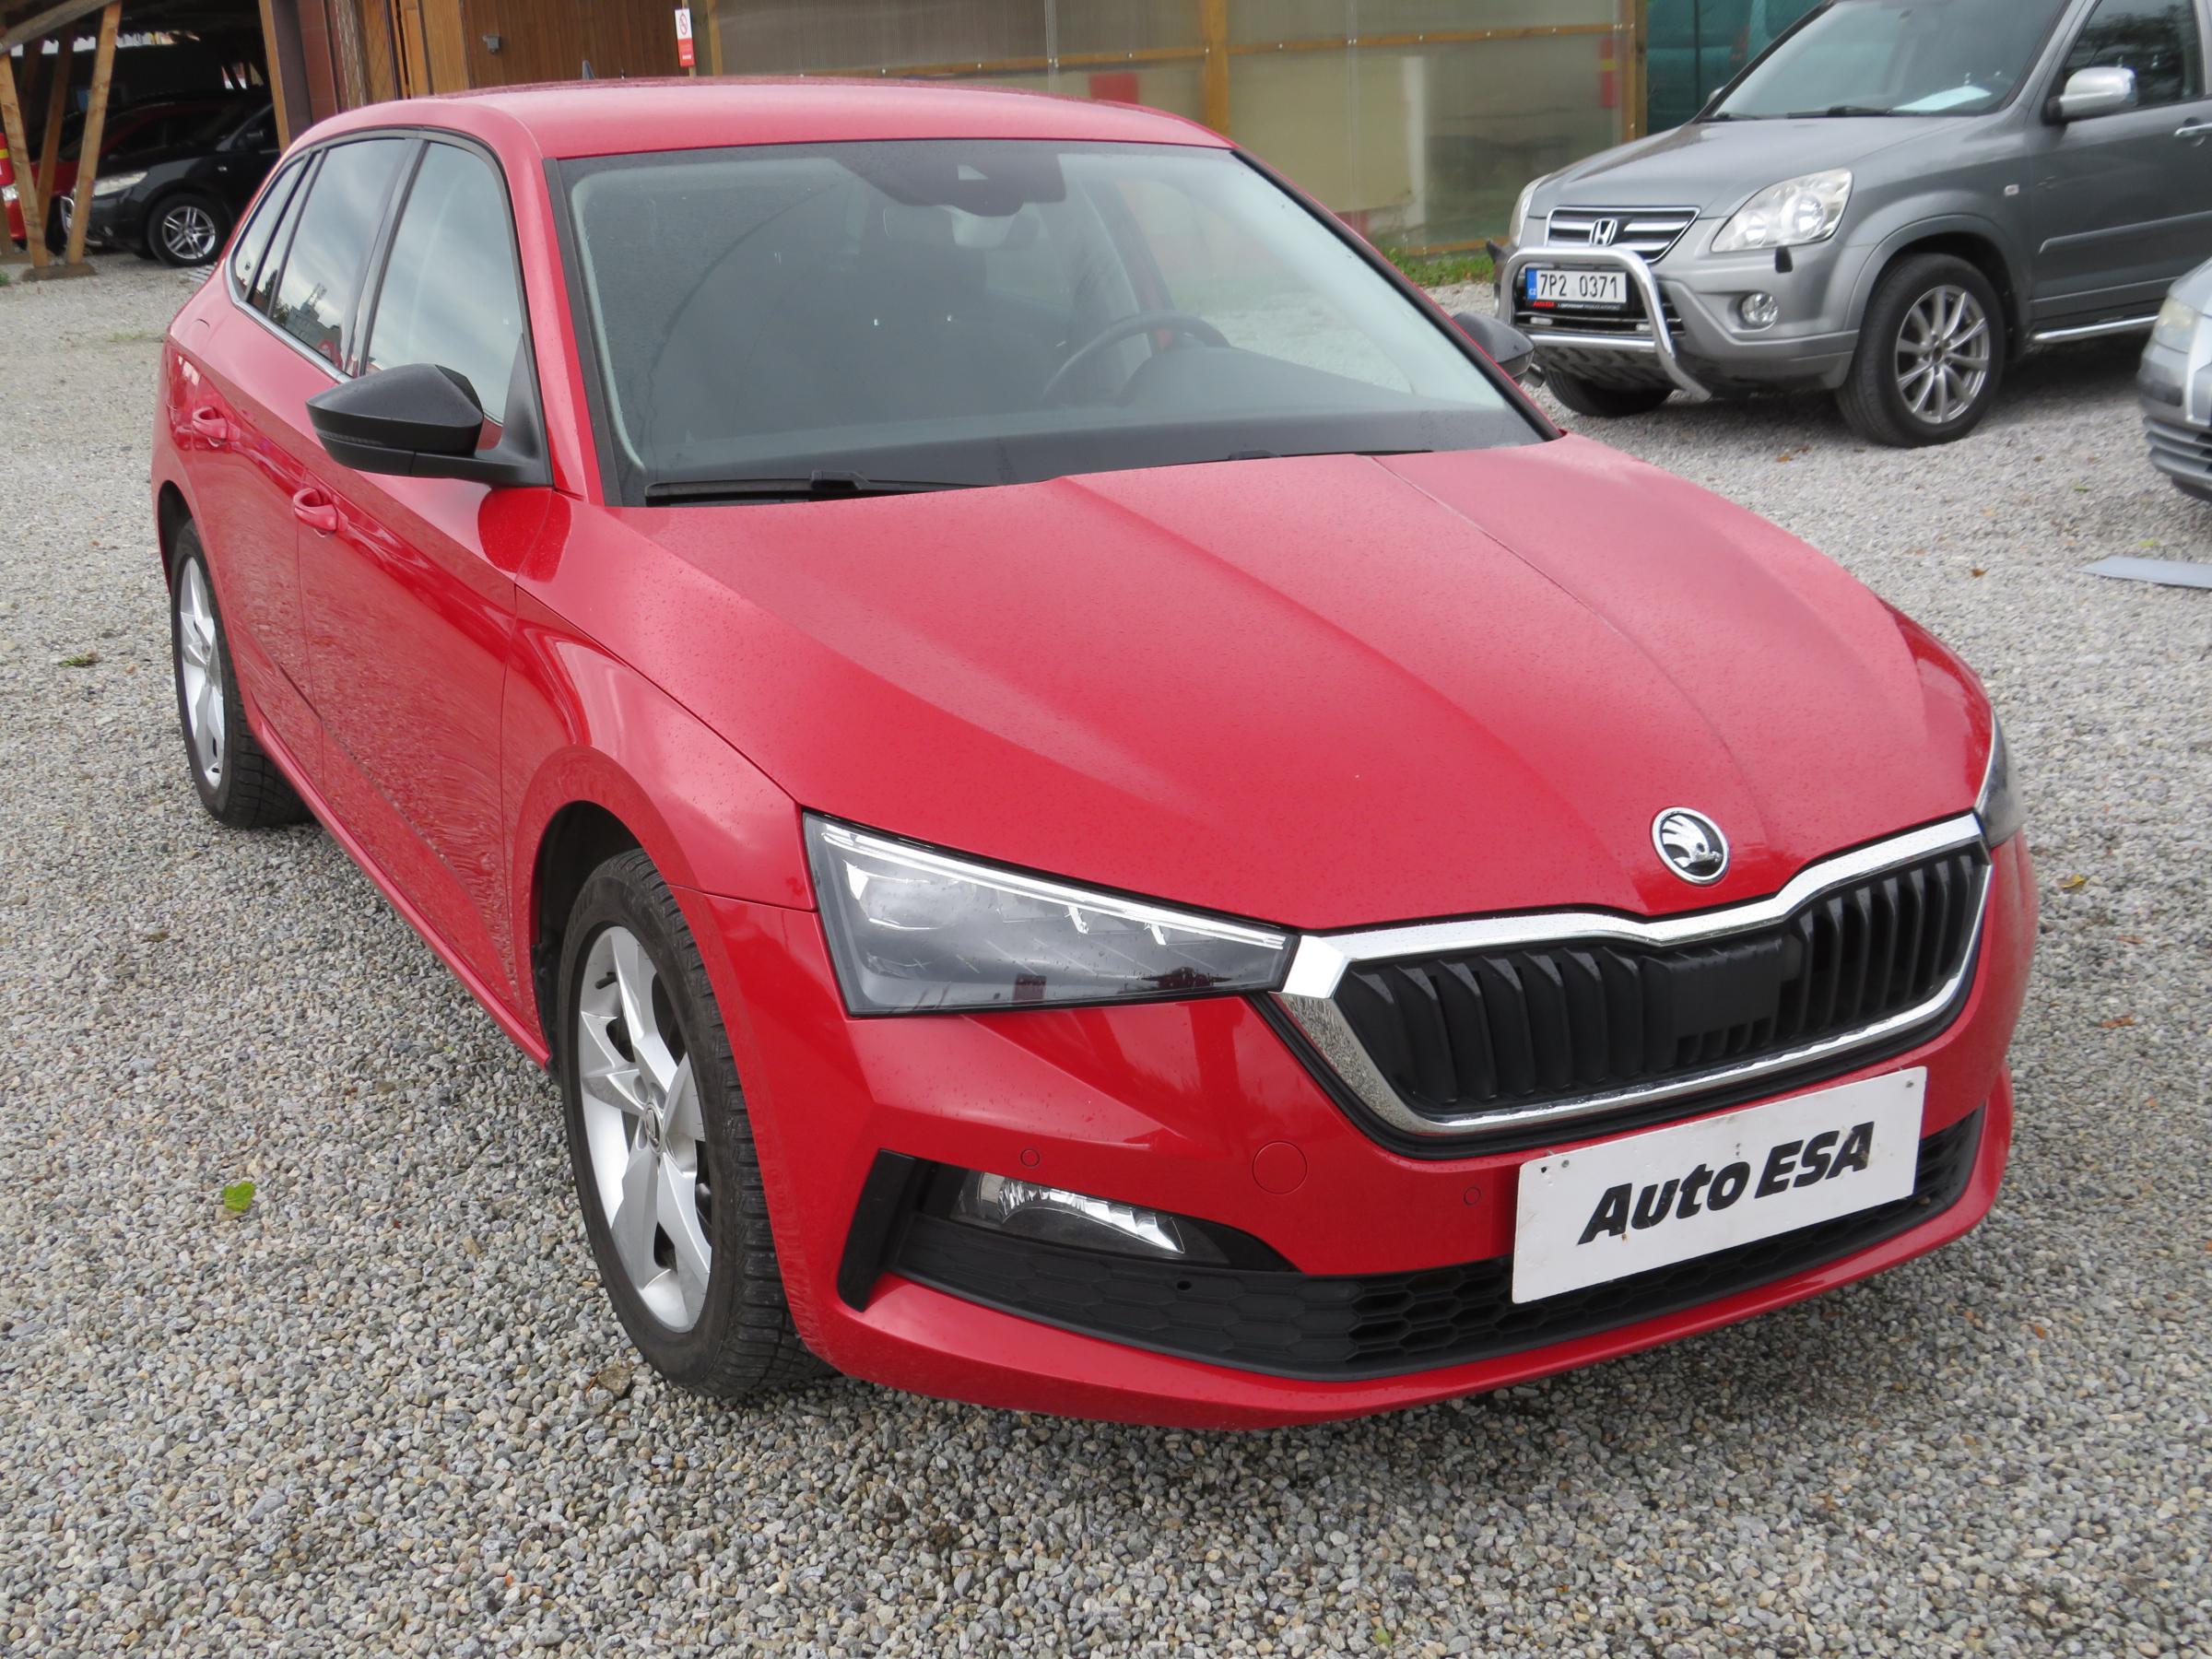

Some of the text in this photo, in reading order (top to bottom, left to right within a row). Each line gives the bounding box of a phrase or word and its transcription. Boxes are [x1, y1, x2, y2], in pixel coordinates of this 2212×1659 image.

[1540, 273, 1618, 299] 7P2 0371
[1577, 1121, 1875, 1245] Auto ESA
